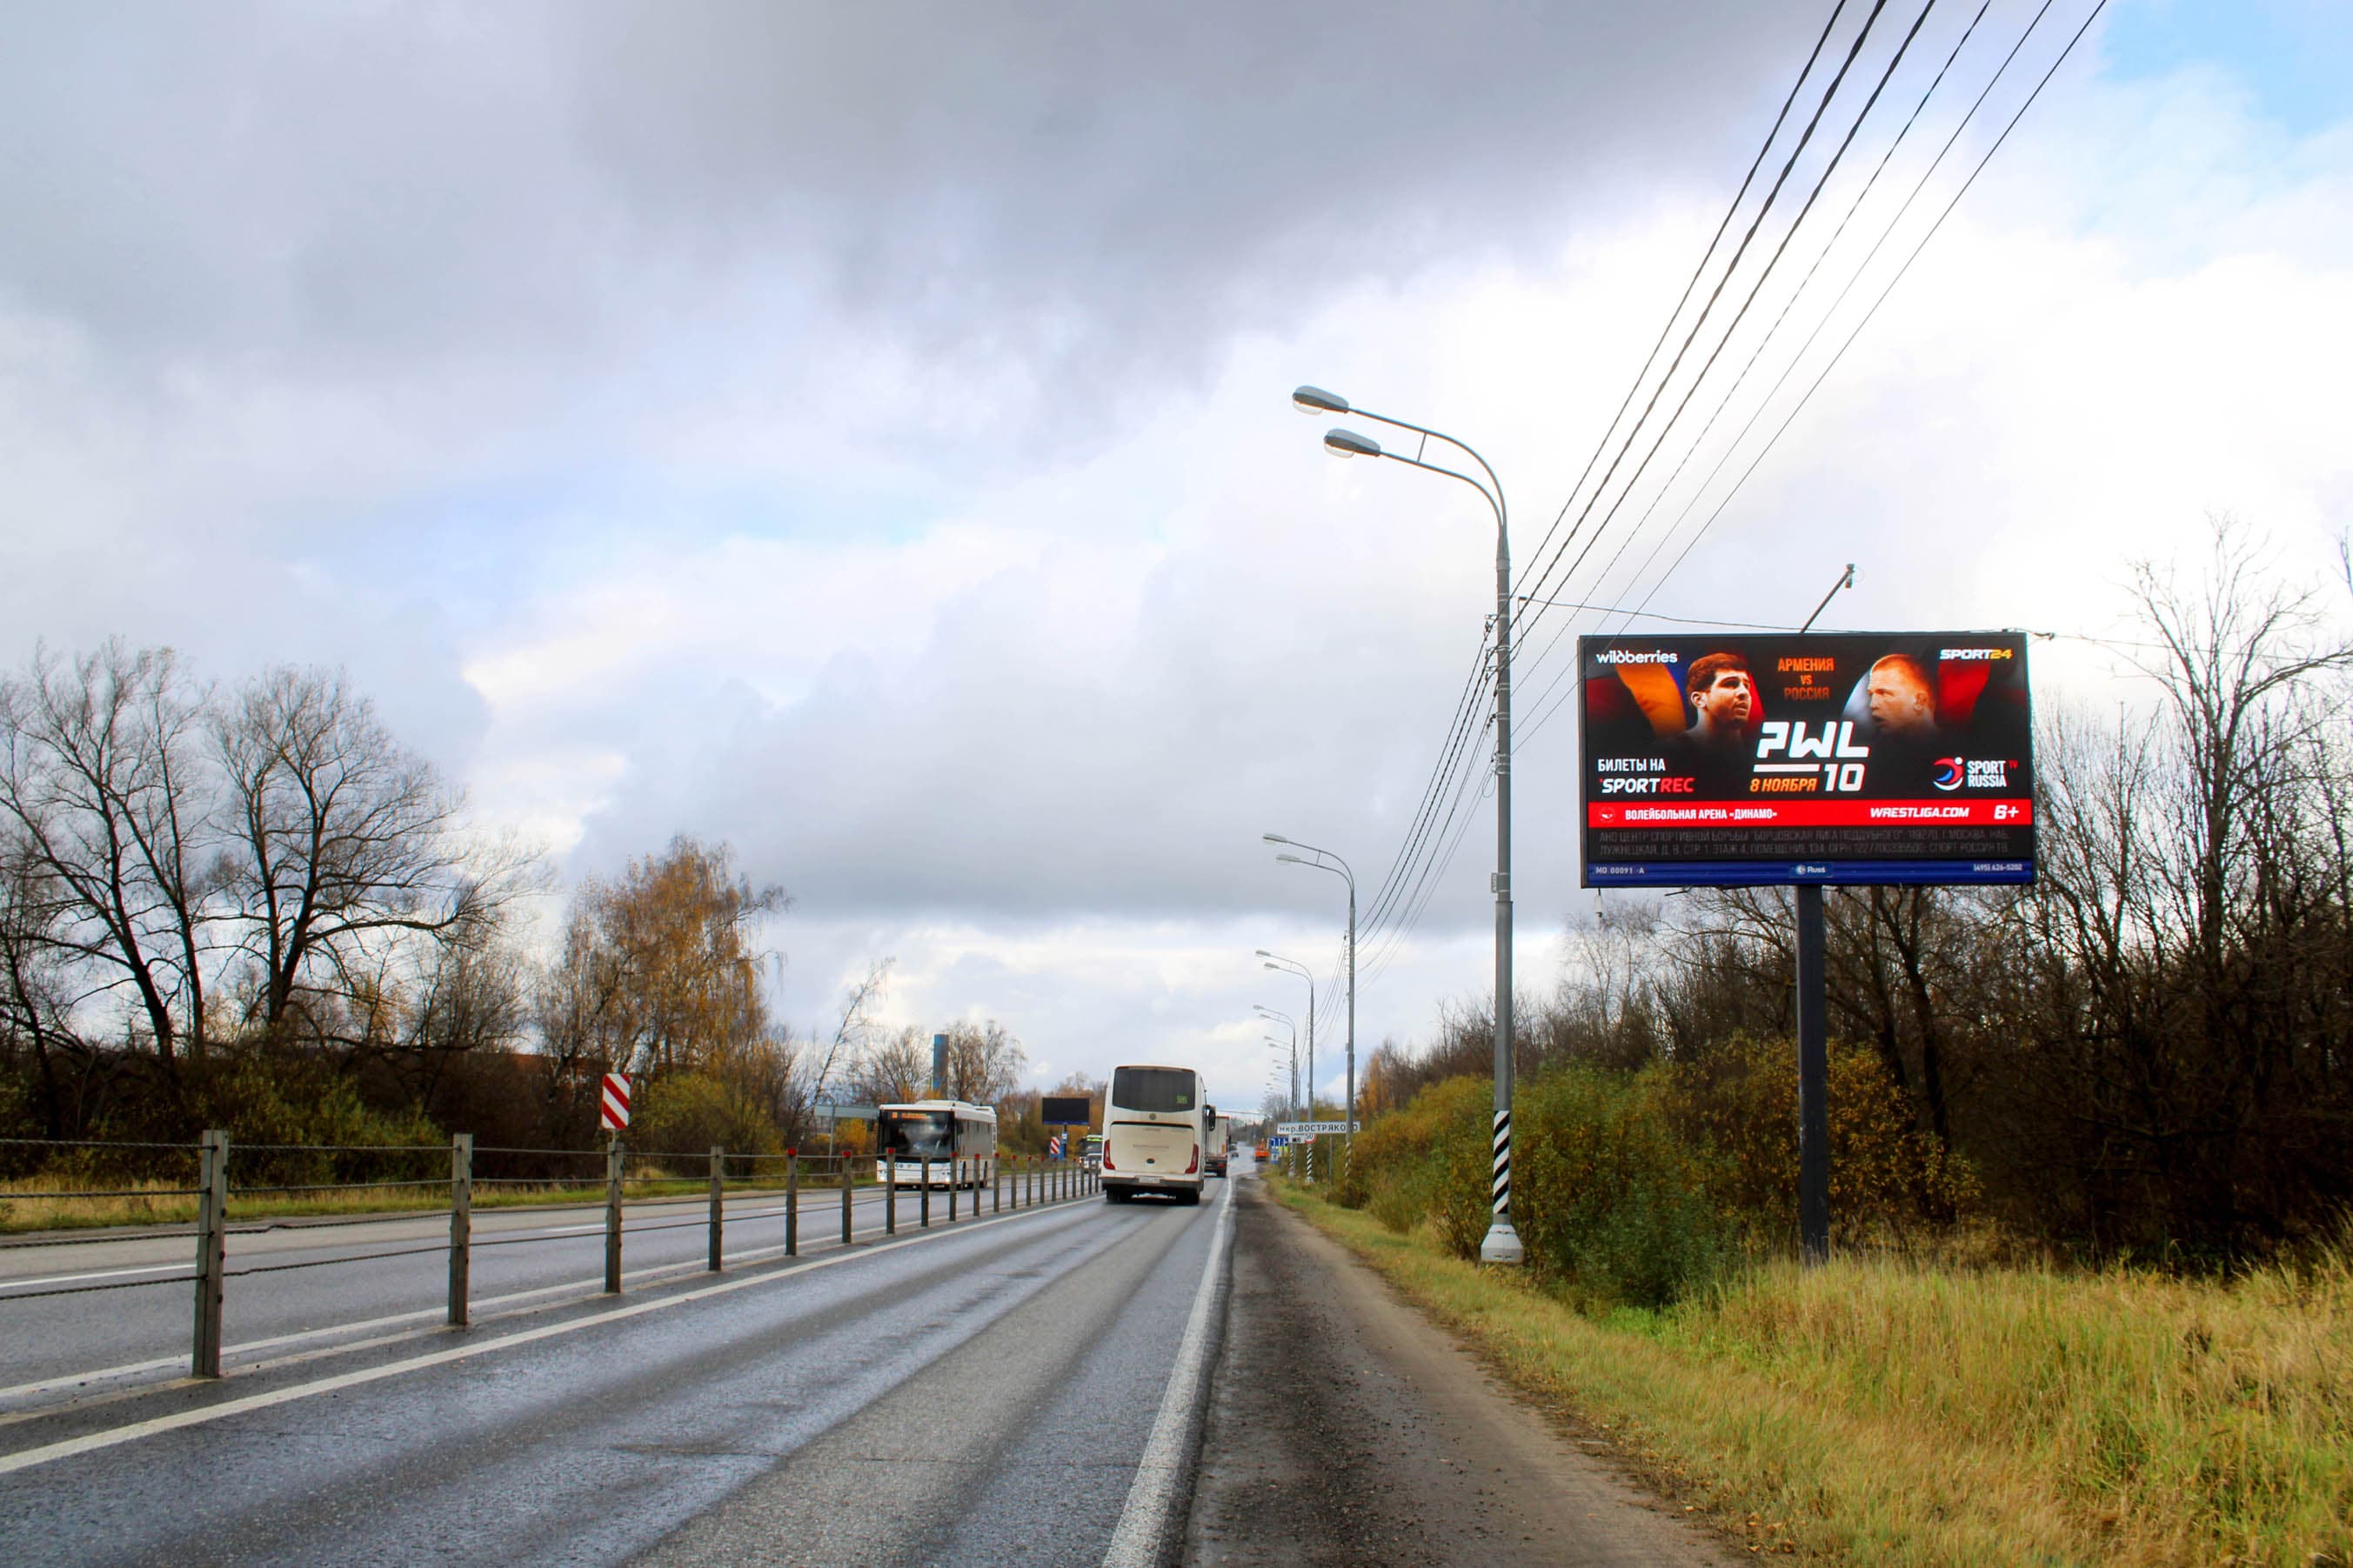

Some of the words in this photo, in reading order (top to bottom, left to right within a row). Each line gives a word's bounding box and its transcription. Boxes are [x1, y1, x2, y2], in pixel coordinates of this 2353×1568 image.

[1595, 650, 1678, 664] wildberries
[1939, 648, 2013, 660] SPORT24
[1777, 657, 1835, 672] АРМЕНИЯ
[1800, 675, 1813, 685] VS
[1784, 687, 1830, 701] РОССИЯ
[1756, 721, 1870, 758] PWL
[1597, 759, 1647, 772] БИЛЕТЫ
[1650, 758, 1666, 771] НА
[1968, 760, 2005, 774] SPORT
[1749, 778, 1760, 792] 8
[1761, 777, 1818, 792] НОЯБРЯ
[1824, 764, 1866, 791] 10
[1968, 774, 2007, 788] RUSSIA
[1625, 808, 1696, 820] ВОЛЕЙБОЛЬНАЯ
[1698, 809, 1727, 819] АРЕНА
[1729, 808, 1777, 820] «ДИНАМО»
[1869, 807, 1969, 818] WRESTLIGA.COM
[1994, 804, 2019, 820] 6+
[1279, 1124, 1358, 1133] мкр.ВОСТРЯКОО
